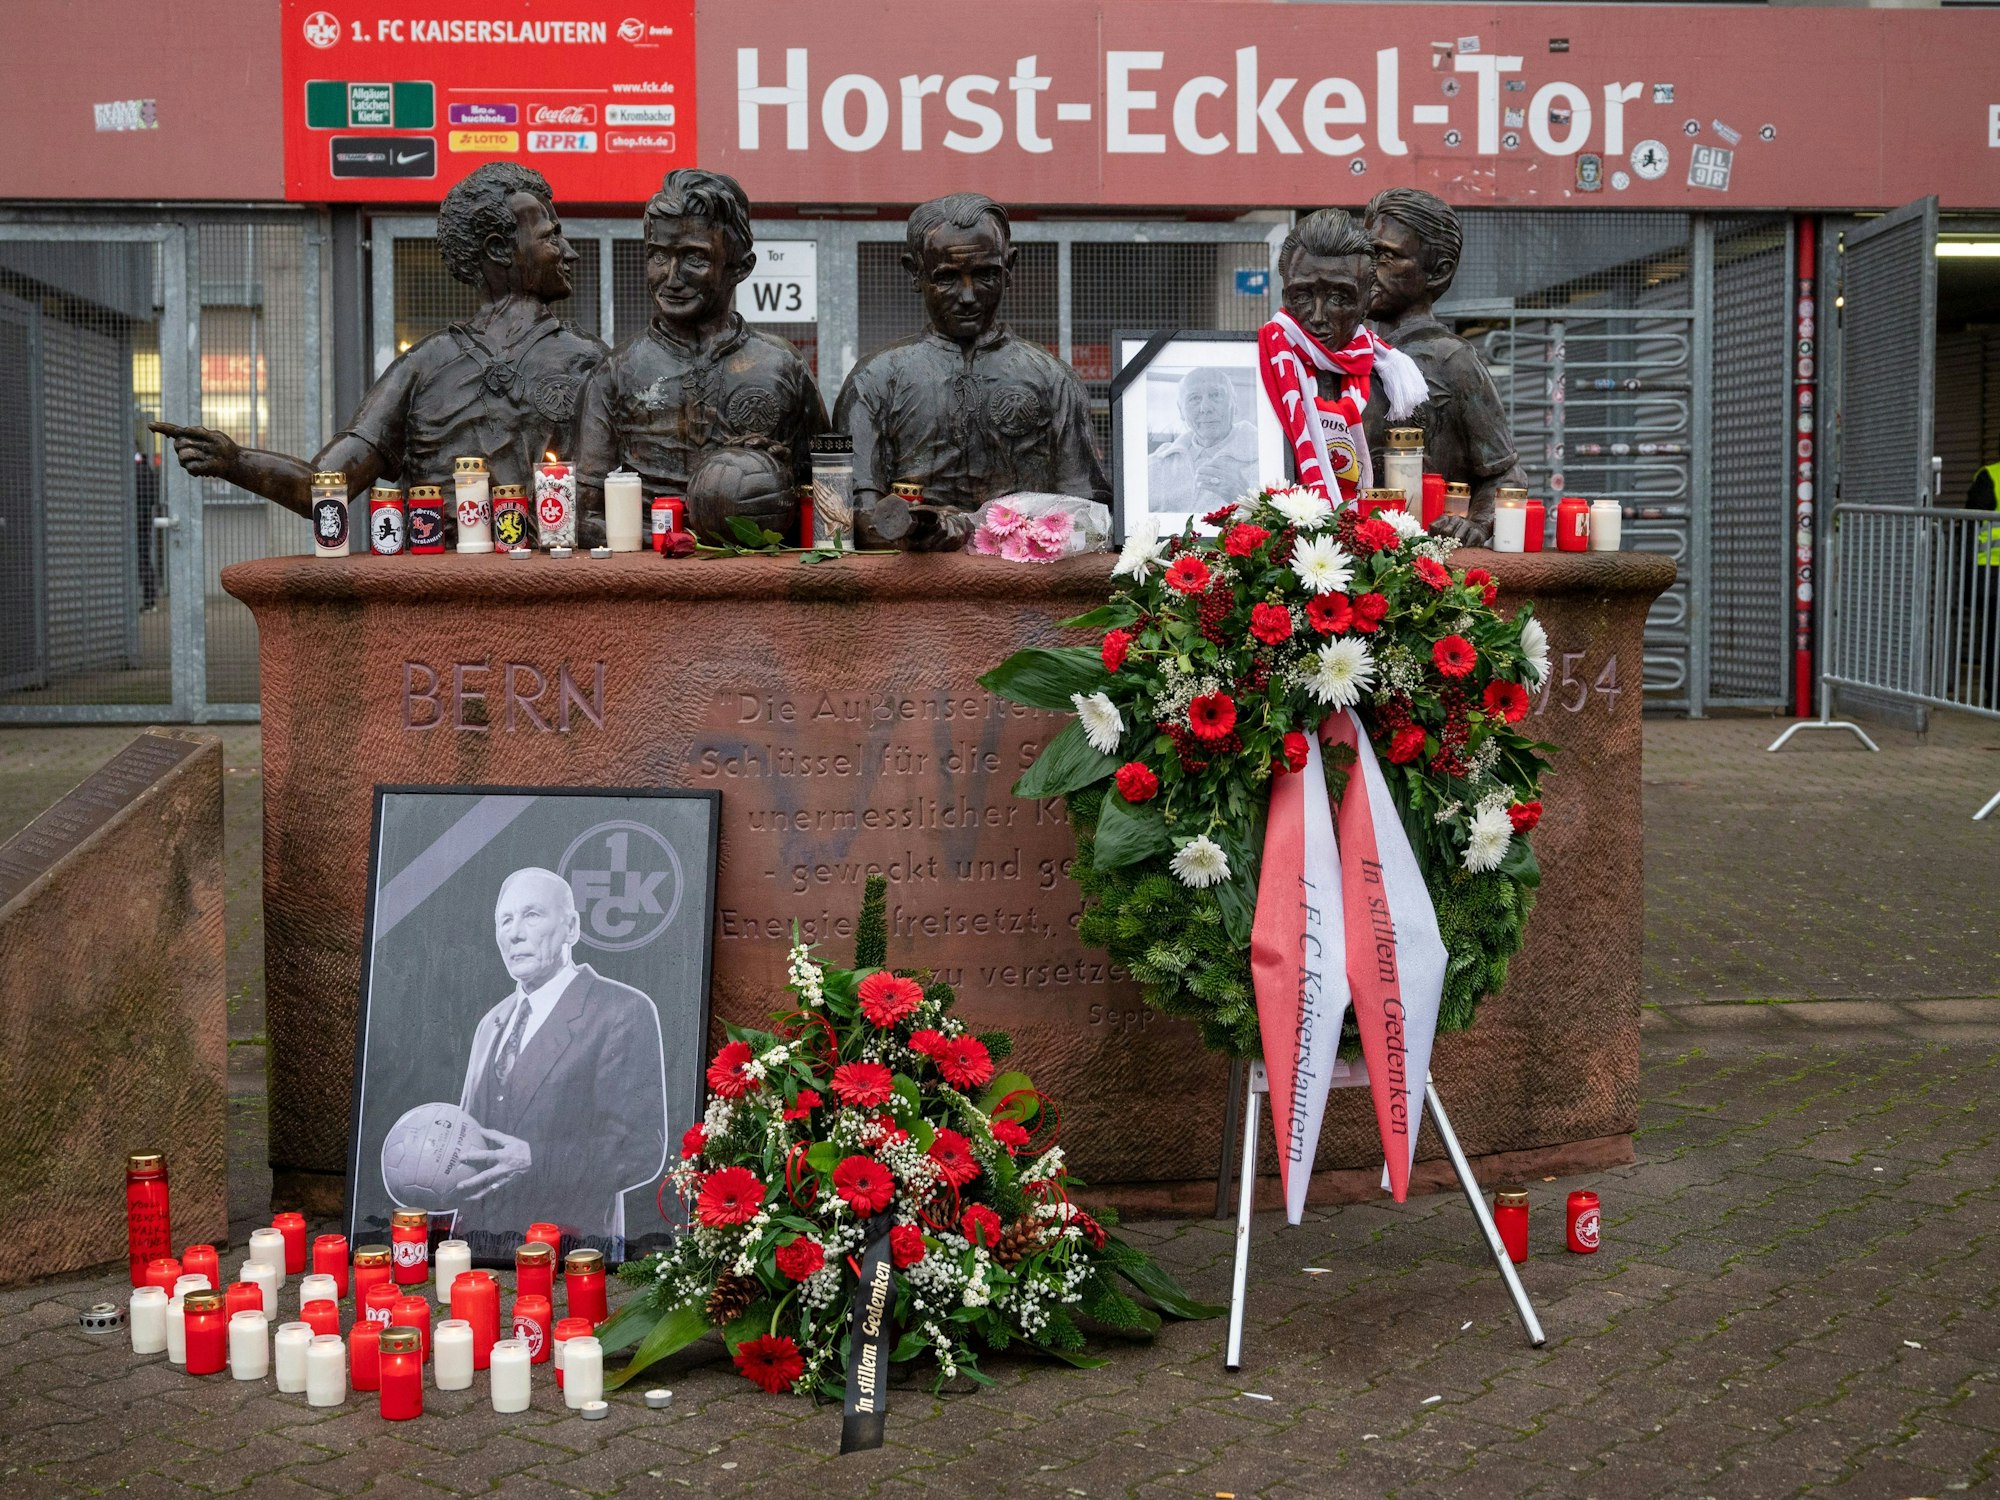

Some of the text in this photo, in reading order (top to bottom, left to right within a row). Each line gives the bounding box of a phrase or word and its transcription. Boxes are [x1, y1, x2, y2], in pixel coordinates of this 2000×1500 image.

[351, 19, 607, 43] 1. FC KAISERSLAUTERN
[648, 25, 673, 36] bwin
[352, 87, 389, 100] Allgäuer
[612, 82, 675, 93] www.fck.de
[737, 45, 1644, 156] Horst-Eckel-Tor
[352, 100, 389, 110] Latschen
[461, 113, 506, 122] buchholz
[619, 109, 672, 122] Krombacher
[474, 134, 508, 144] LOTTO
[612, 136, 669, 147] shop.fck.de
[767, 250, 785, 261] Tor
[753, 282, 803, 312] W3
[403, 660, 605, 732] BERN
[700, 743, 864, 779] Schlüssel
[881, 742, 930, 776] für
[945, 740, 1001, 775] die
[749, 795, 1019, 832] unermesslicher
[955, 847, 1022, 883] und
[978, 957, 1135, 988] versetze
[1360, 856, 1411, 1136] In stillem Gedenken
[1088, 1003, 1155, 1033] Sepp
[1285, 966, 1322, 1164] Kaiserslautern
[855, 1260, 891, 1414] In stillem Gedenken
